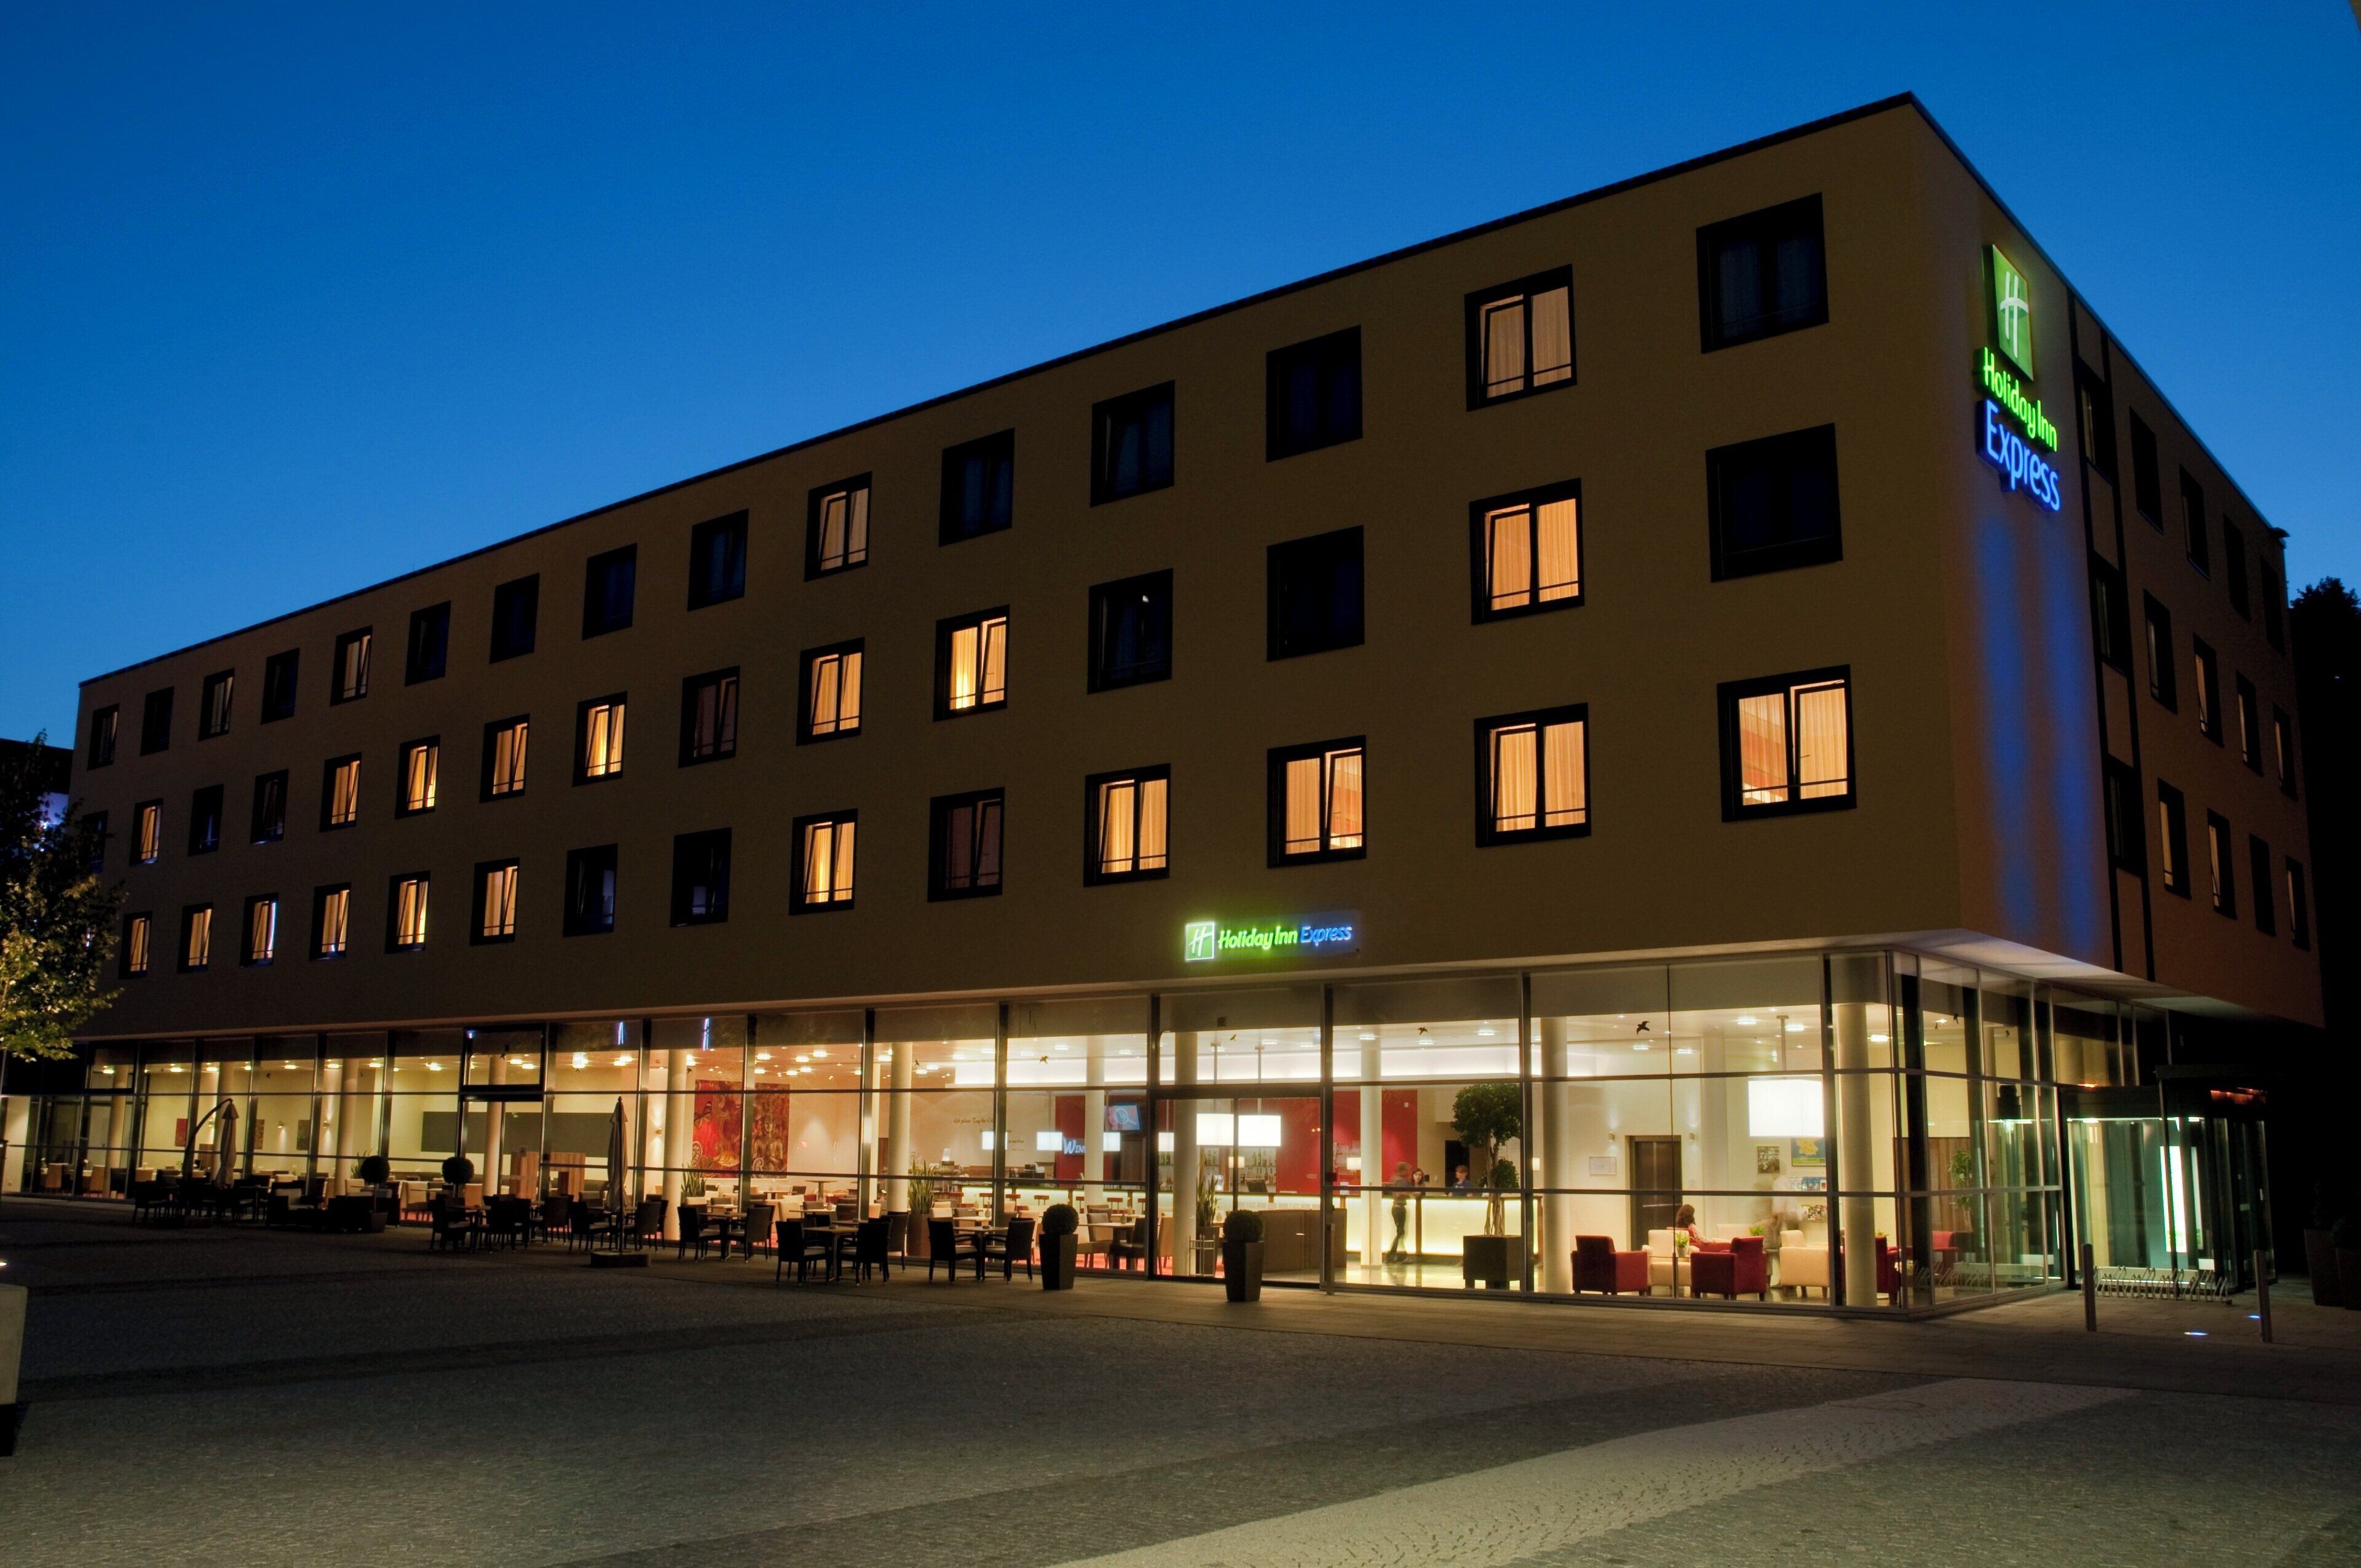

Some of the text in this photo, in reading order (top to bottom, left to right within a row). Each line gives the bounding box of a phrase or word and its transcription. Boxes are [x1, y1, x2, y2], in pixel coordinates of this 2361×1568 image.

[1983, 346, 2057, 452] Holiday Inn
[1987, 398, 2060, 511] Express
[1218, 925, 1353, 950] Holiday Inn Express
